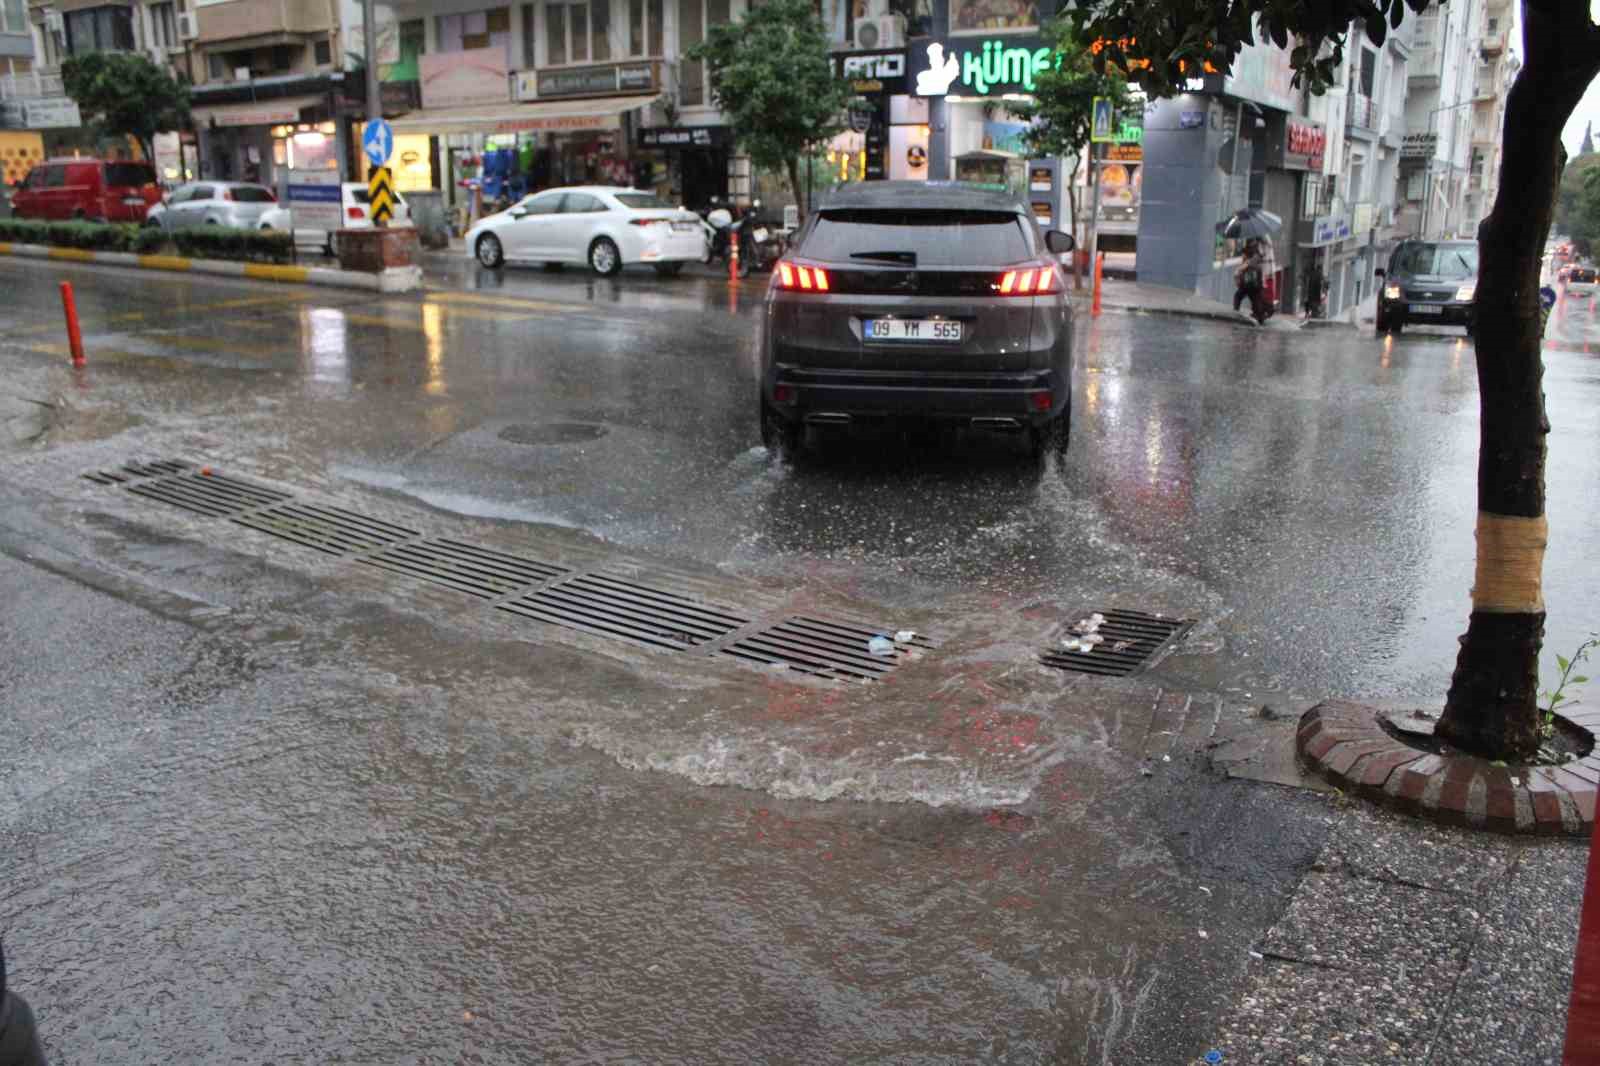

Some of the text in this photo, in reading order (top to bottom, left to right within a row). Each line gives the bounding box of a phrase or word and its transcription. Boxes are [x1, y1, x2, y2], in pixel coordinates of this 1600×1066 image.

[963, 41, 1062, 93] KÜME
[872, 321, 959, 337] 09 YM 565
